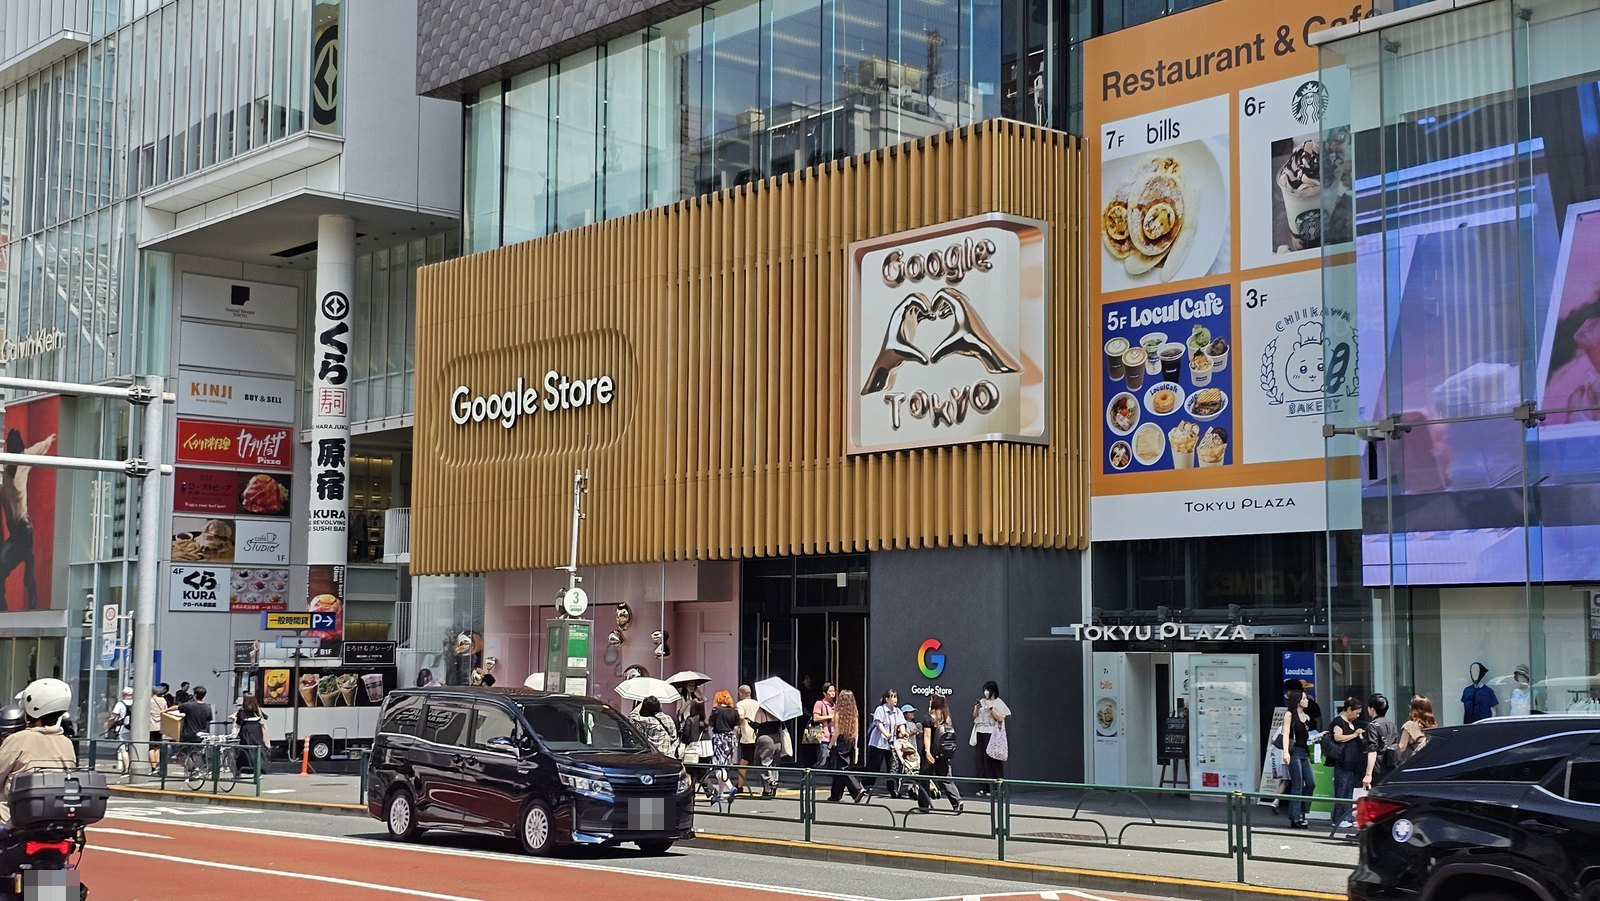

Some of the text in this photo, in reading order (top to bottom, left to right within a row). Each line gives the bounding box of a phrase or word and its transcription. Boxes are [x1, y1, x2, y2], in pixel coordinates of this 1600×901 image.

[1102, 33, 1265, 102] Restaurant
[1273, 24, 1297, 57] &
[1244, 97, 1265, 117] 6F
[1106, 118, 1181, 150] 7F bills
[882, 237, 996, 288] Google
[1246, 288, 1268, 309] 3F
[1107, 310, 1127, 331] 5F
[1275, 306, 1350, 333] CHIIKAWA
[2, 327, 65, 361] Calvin Klein
[319, 321, 349, 385] くら
[191, 382, 233, 399] KINJI
[244, 394, 258, 402] BUY
[267, 396, 282, 404] SELL
[450, 370, 613, 429] Google Store
[884, 379, 1000, 431] TOKYO
[1288, 399, 1340, 414] BAKERY
[257, 456, 282, 465] Pizza
[317, 438, 347, 501] 原宿
[313, 509, 346, 519] KURA
[1184, 497, 1296, 513] TOKYU PLAZA
[277, 554, 285, 562] 1F
[183, 570, 217, 590] くら
[183, 590, 216, 600] KURA
[573, 591, 580, 604] 3
[312, 613, 322, 629] P
[1070, 621, 1248, 641] TOKYU PLAZA
[918, 638, 945, 679] G
[911, 685, 953, 696] Google Store
